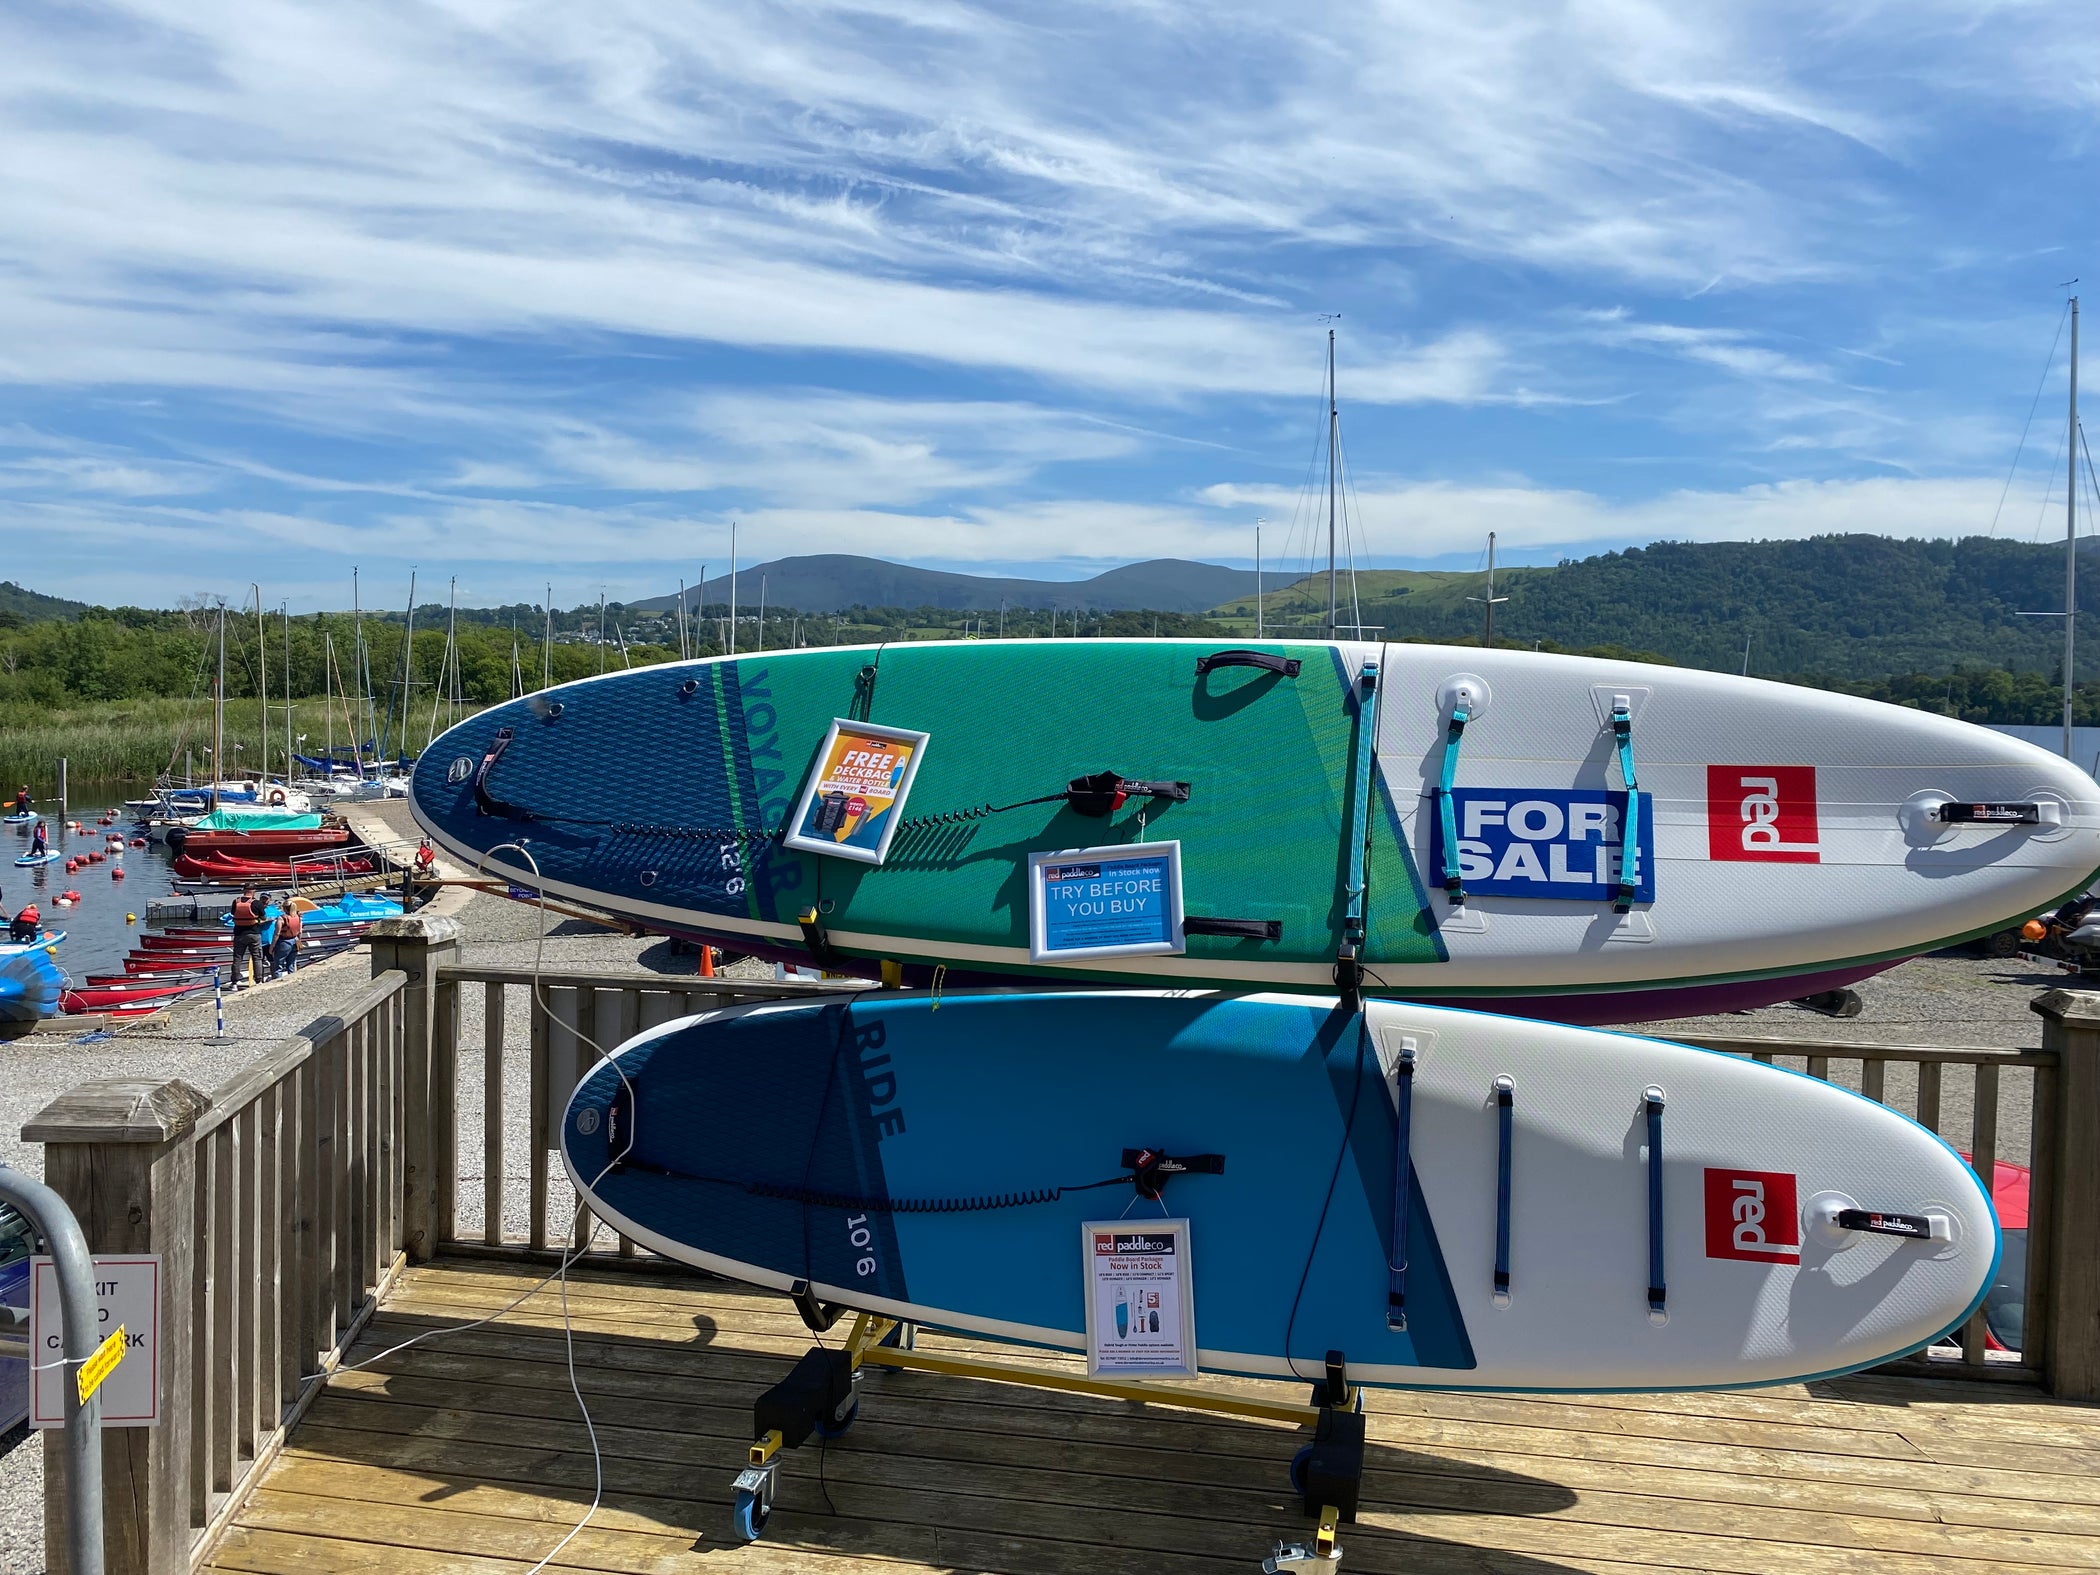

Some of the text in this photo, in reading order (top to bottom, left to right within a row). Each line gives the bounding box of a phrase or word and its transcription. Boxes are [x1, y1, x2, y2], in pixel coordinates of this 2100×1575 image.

[842, 750, 894, 770] FREE
[741, 669, 802, 894] VOYAGER
[833, 765, 892, 780] DECKBAG
[836, 775, 862, 784] WATER
[862, 779, 891, 788] BOTTLE
[840, 784, 858, 792] EVERY
[868, 788, 891, 796] BOARD
[1463, 800, 1620, 842] FOR
[1741, 776, 1820, 853] red
[720, 840, 745, 895] 12'6
[1047, 865, 1094, 880] red paddleco
[1118, 868, 1141, 877] Stock
[1142, 867, 1162, 875] Now
[1441, 840, 1643, 885] SALE
[1050, 879, 1162, 901] TRY BEFORE
[1068, 898, 1147, 917] YOU BUY
[856, 1019, 907, 1142] RIDE
[1732, 1179, 1800, 1255] red
[1883, 1217, 1913, 1230] paddleco
[847, 1214, 876, 1277] 10'6
[1097, 1234, 1164, 1253] red paddleco
[1110, 1261, 1162, 1270] Now in Stock
